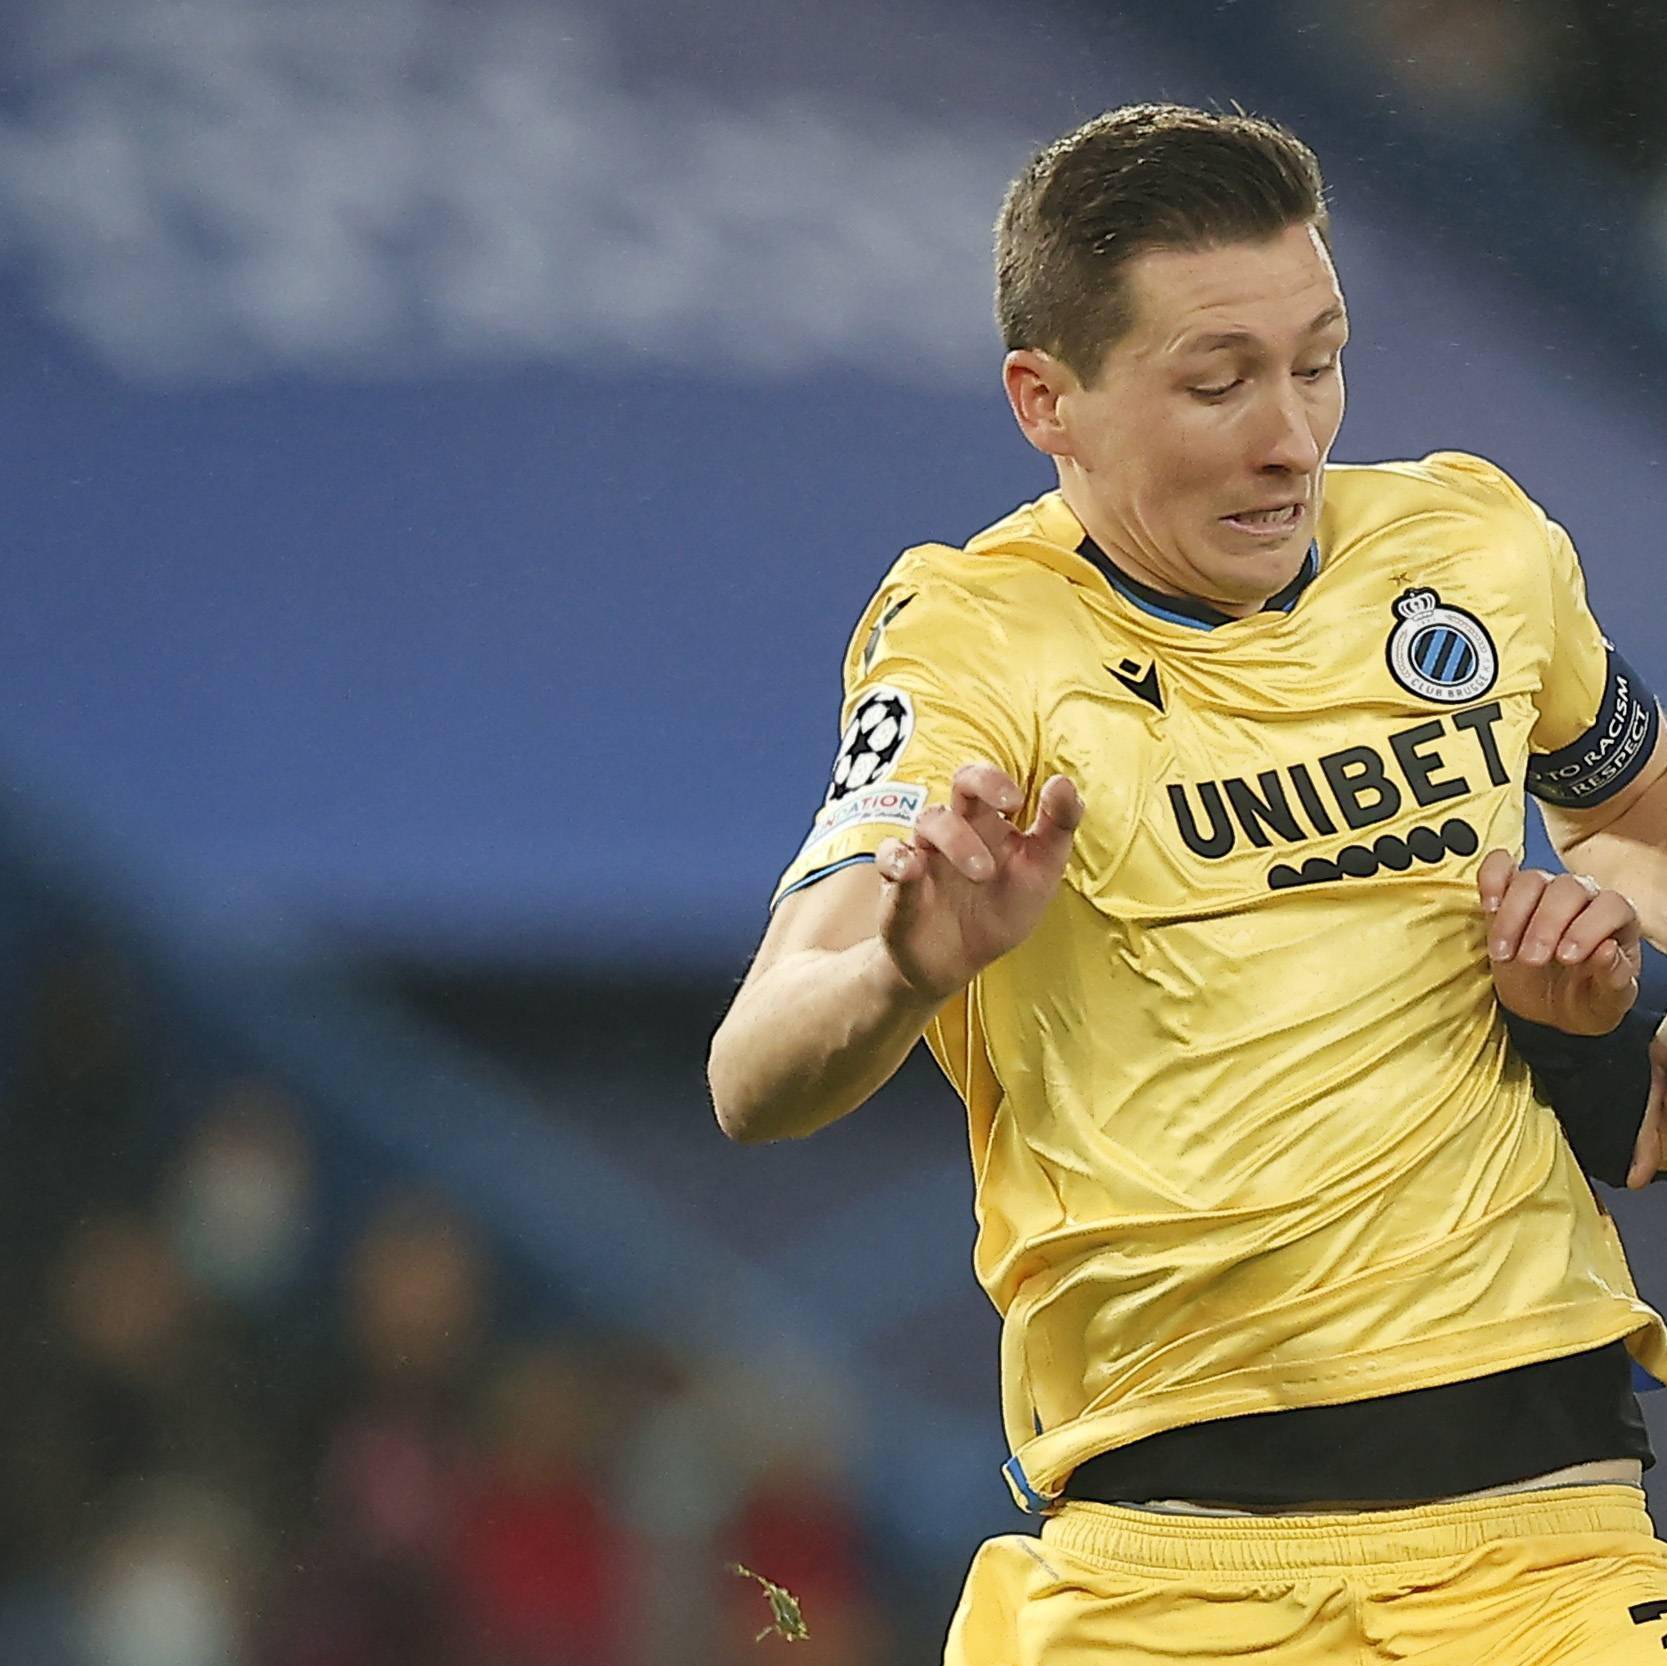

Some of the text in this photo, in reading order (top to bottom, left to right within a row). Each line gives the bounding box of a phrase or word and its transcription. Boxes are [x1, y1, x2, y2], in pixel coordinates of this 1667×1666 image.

[1166, 701, 1511, 859] UNIBET
[1548, 674, 1629, 781] TO RACISM
[1571, 703, 1648, 795] RESPECT
